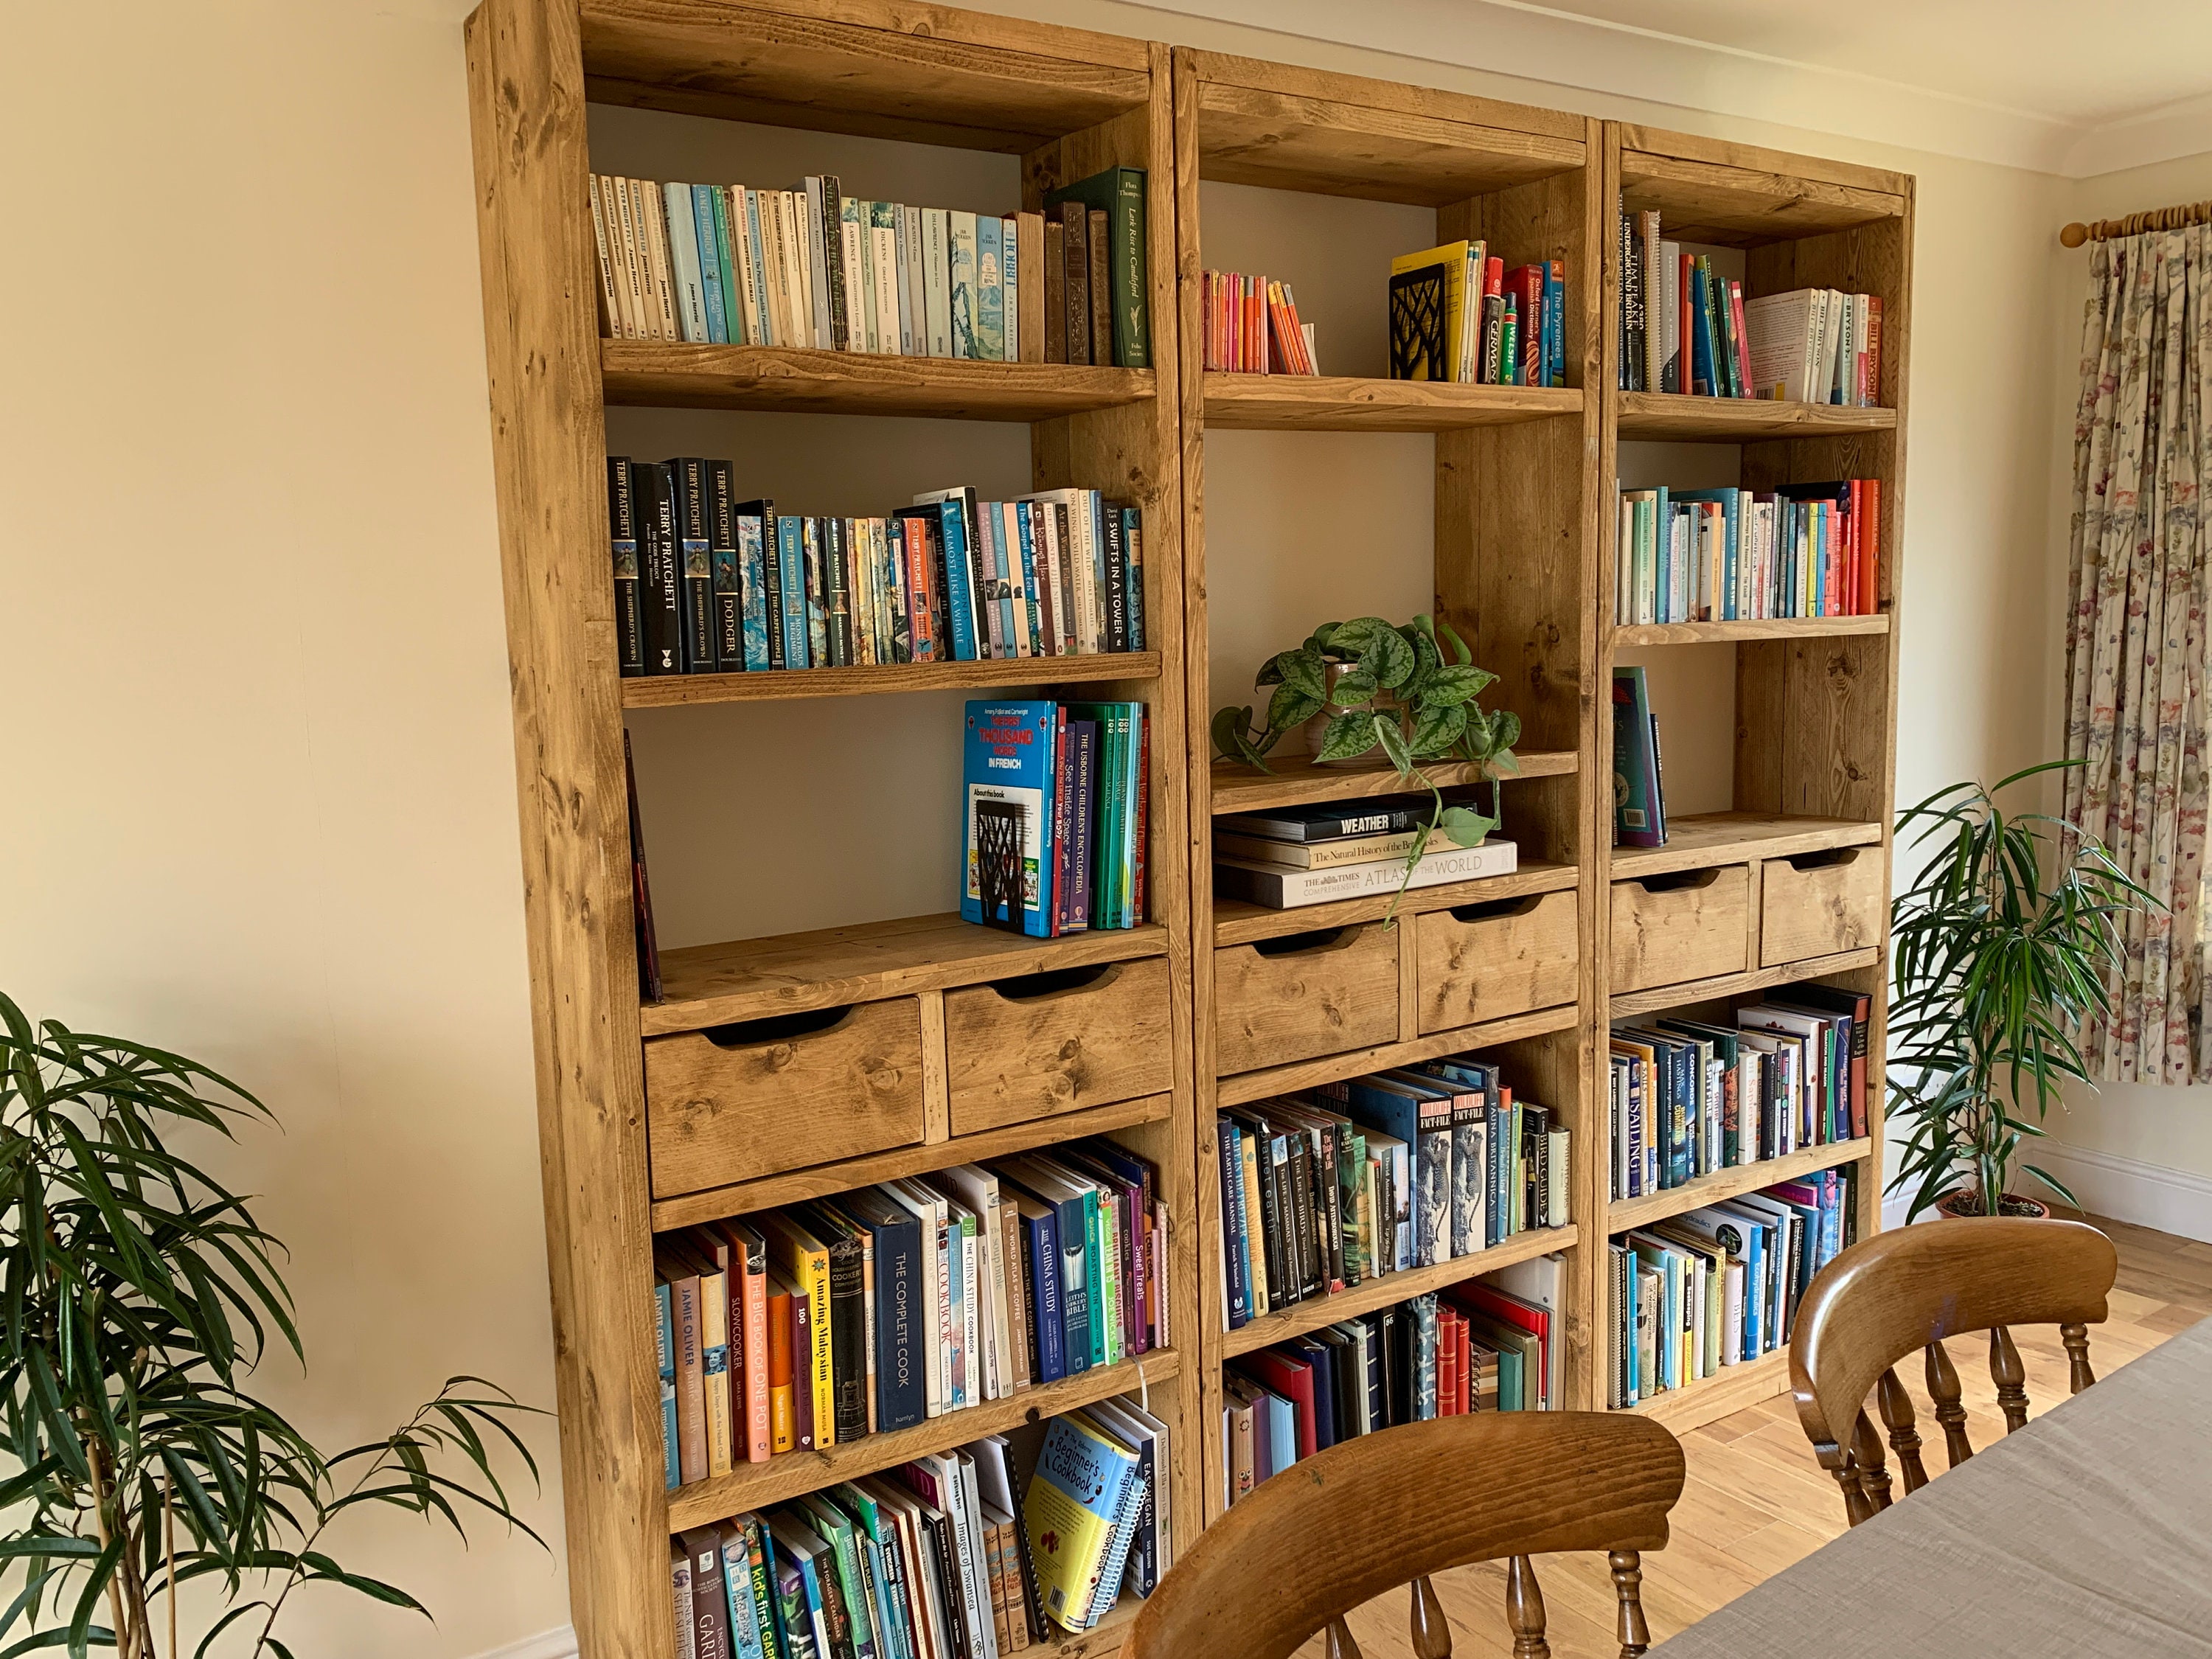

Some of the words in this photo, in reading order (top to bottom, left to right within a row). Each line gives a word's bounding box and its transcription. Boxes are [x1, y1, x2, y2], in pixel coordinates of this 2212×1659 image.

[1128, 207, 1136, 226] Lark
[602, 257, 610, 275] James
[1005, 237, 1016, 289] HOBBIT
[1128, 257, 1138, 298] Candleford
[605, 275, 613, 297] Herriot
[1508, 327, 1516, 362] WELSH
[1554, 313, 1562, 358] Pyrenees
[1868, 348, 1877, 394] BRYSON
[616, 461, 626, 487] TERRY
[717, 470, 726, 496] TERRY
[619, 488, 630, 537] PRATCHETT
[1071, 493, 1075, 507] ON
[660, 499, 671, 536] TERRY
[719, 498, 729, 547] PRATCHETT
[768, 528, 776, 566] PRATCHETT
[945, 529, 956, 570] ALMOST
[1023, 551, 1029, 559] of
[1036, 526, 1046, 559] Running
[1109, 523, 1119, 563] SWIFTS
[661, 541, 676, 611] PRATCHETT
[950, 572, 959, 596] LIKE
[1040, 563, 1048, 582] Hare
[1111, 567, 1119, 578] IN
[1112, 582, 1120, 590] A
[724, 599, 737, 653] DODGER
[953, 609, 964, 644] WHALE
[1113, 593, 1122, 634] TOWER
[789, 622, 797, 662] REGIMENT
[795, 619, 804, 667] MONSTROUS
[979, 728, 1034, 745] THOUSAND
[989, 758, 995, 768] IN
[995, 759, 1021, 769] FRENCH
[1065, 765, 1073, 784] See
[1079, 750, 1088, 787] USBORNE
[1065, 785, 1073, 815] Inside
[1078, 789, 1086, 833] CHILDREN'S
[1062, 818, 1071, 845] Space
[1341, 815, 1389, 834] WEATHER
[1076, 835, 1085, 894] ENCYCLOPEDIA
[1314, 852, 1329, 862] The
[1331, 848, 1355, 859] Natural
[1357, 844, 1382, 857] History
[1383, 844, 1392, 852] of
[1391, 842, 1401, 852] the
[1304, 878, 1319, 887] THE
[1338, 873, 1360, 883] TIMES
[1365, 866, 1408, 886] ATLAS
[1420, 865, 1434, 874] THE
[1436, 856, 1482, 876] WORLD
[1304, 883, 1360, 897] COMPREHENSIVE
[1421, 1101, 1450, 1116] WILDLIFE
[1454, 1094, 1484, 1108] WILDLIFE
[1455, 1107, 1484, 1121] FACT-FILE
[1421, 1115, 1450, 1128] FACT-FILE
[1630, 1104, 1640, 1169] SAILING
[1259, 1130, 1271, 1183] planet
[1265, 1189, 1275, 1234] earth
[896, 1252, 906, 1278] THE
[965, 1257, 973, 1286] CHINA
[1043, 1245, 1053, 1279] CHINA
[1135, 1245, 1144, 1270] Sweet
[752, 1279, 762, 1298] THE
[832, 1270, 862, 1281] COOKERY
[1136, 1273, 1144, 1301] Treats
[682, 1289, 692, 1321] JAMIE
[815, 1278, 827, 1325] Amazing
[939, 1263, 950, 1344] COOKBOOK
[1045, 1281, 1055, 1312] STUDY
[753, 1301, 763, 1325] BIG
[798, 1308, 806, 1324] 100
[896, 1281, 908, 1345] COMPLETE
[1385, 1316, 1394, 1326] 86
[683, 1323, 694, 1366] OLIVER
[732, 1297, 742, 1369] SLOWCOOKER
[754, 1326, 763, 1359] BOOK
[755, 1360, 764, 1371] OF
[816, 1327, 830, 1381] Malaysian
[897, 1349, 908, 1388] COOK
[755, 1374, 767, 1402] ONE
[756, 1404, 768, 1430] POT
[896, 1415, 915, 1423] hamlyn
[1055, 1437, 1099, 1477] Beginner's
[1052, 1455, 1093, 1495] Cookbook
[1113, 1466, 1135, 1520] Beginner's
[1144, 1491, 1152, 1526] VEGAN
[957, 1522, 967, 1556] Images
[1096, 1524, 1116, 1572] Cookbook
[886, 1546, 894, 1581] EVERGREEN
[959, 1558, 968, 1567] of
[752, 1568, 765, 1600] kid's
[964, 1569, 975, 1610] Swansea
[757, 1601, 771, 1630] first
[824, 1571, 835, 1604] FORAGER'S
[831, 1604, 841, 1639] CALENDAR
